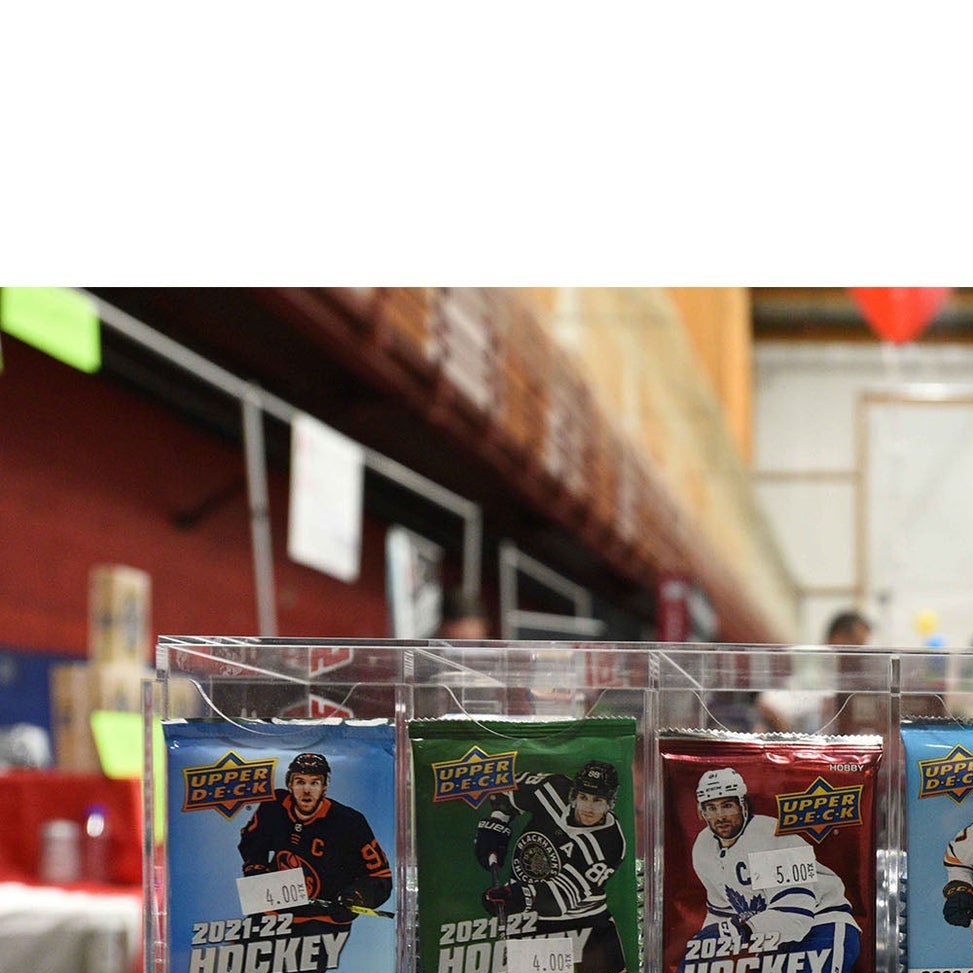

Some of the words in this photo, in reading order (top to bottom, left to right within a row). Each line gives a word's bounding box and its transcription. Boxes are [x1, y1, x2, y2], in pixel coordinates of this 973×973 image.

[191, 768, 269, 787] UPPER
[440, 760, 509, 780] UPPER
[829, 763, 865, 772] HOBBY
[783, 794, 856, 813] UPPER
[311, 838, 325, 857] C
[559, 841, 574, 858] A
[736, 861, 751, 886] C
[776, 863, 808, 884] 5.00
[265, 884, 298, 905] 4.00
[191, 912, 294, 945] 2021-22
[439, 911, 539, 945] 2021-22
[685, 931, 781, 961] 2021-22
[533, 953, 564, 972] 4.00
